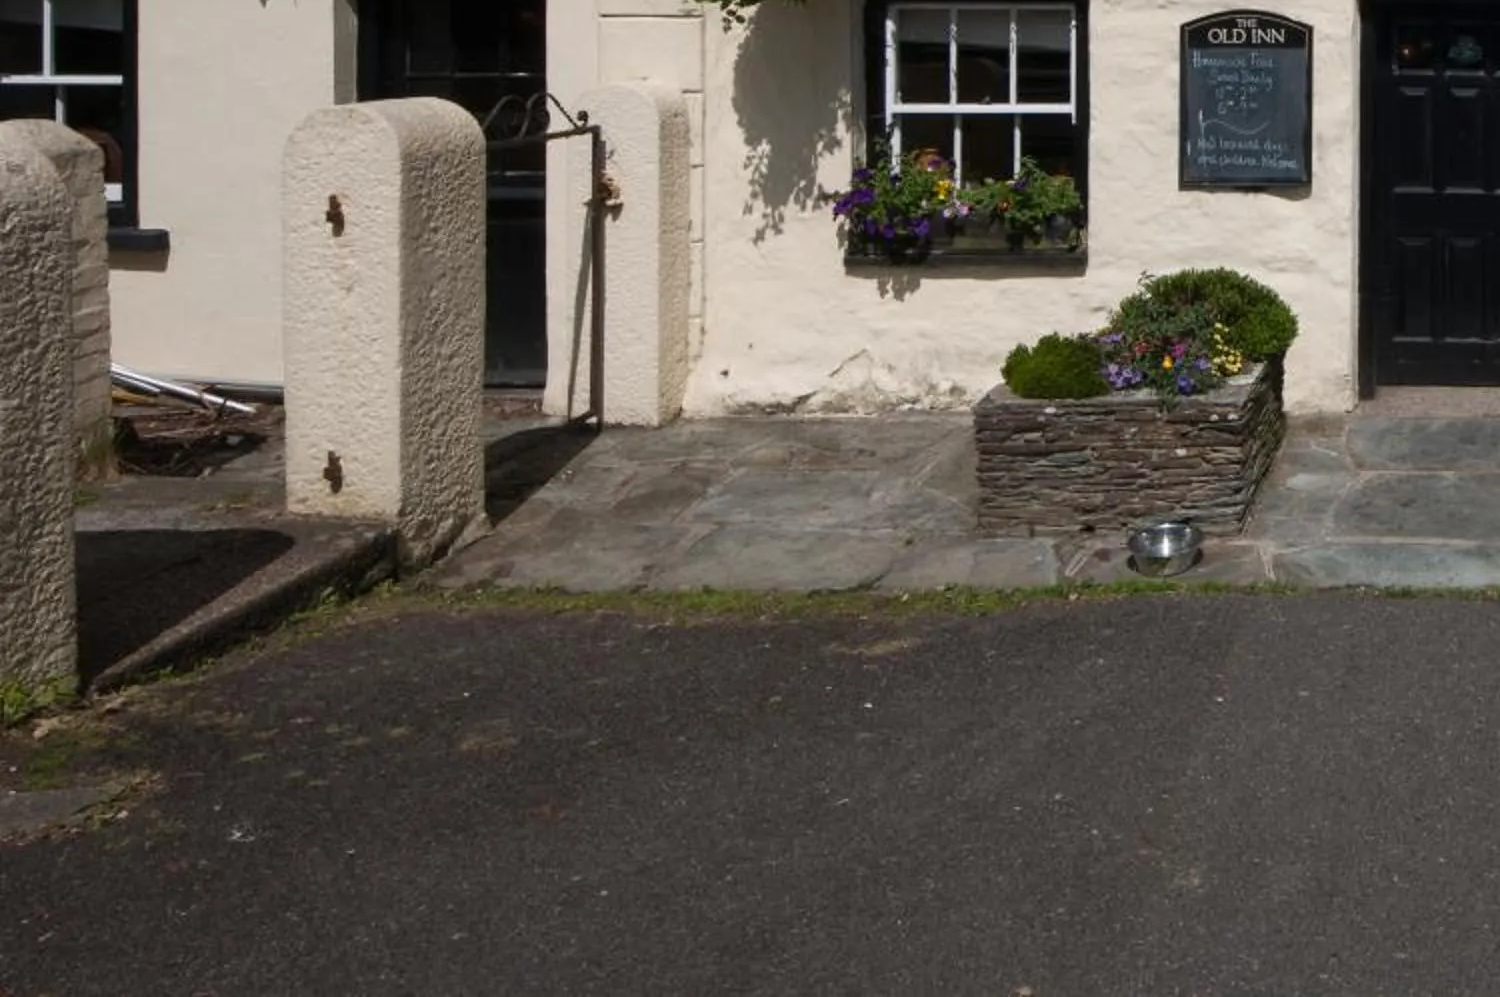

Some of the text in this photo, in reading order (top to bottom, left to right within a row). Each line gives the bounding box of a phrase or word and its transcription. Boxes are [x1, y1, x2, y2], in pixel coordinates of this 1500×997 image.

[1236, 18, 1258, 28] THE
[1208, 28, 1286, 44] OLD INN
